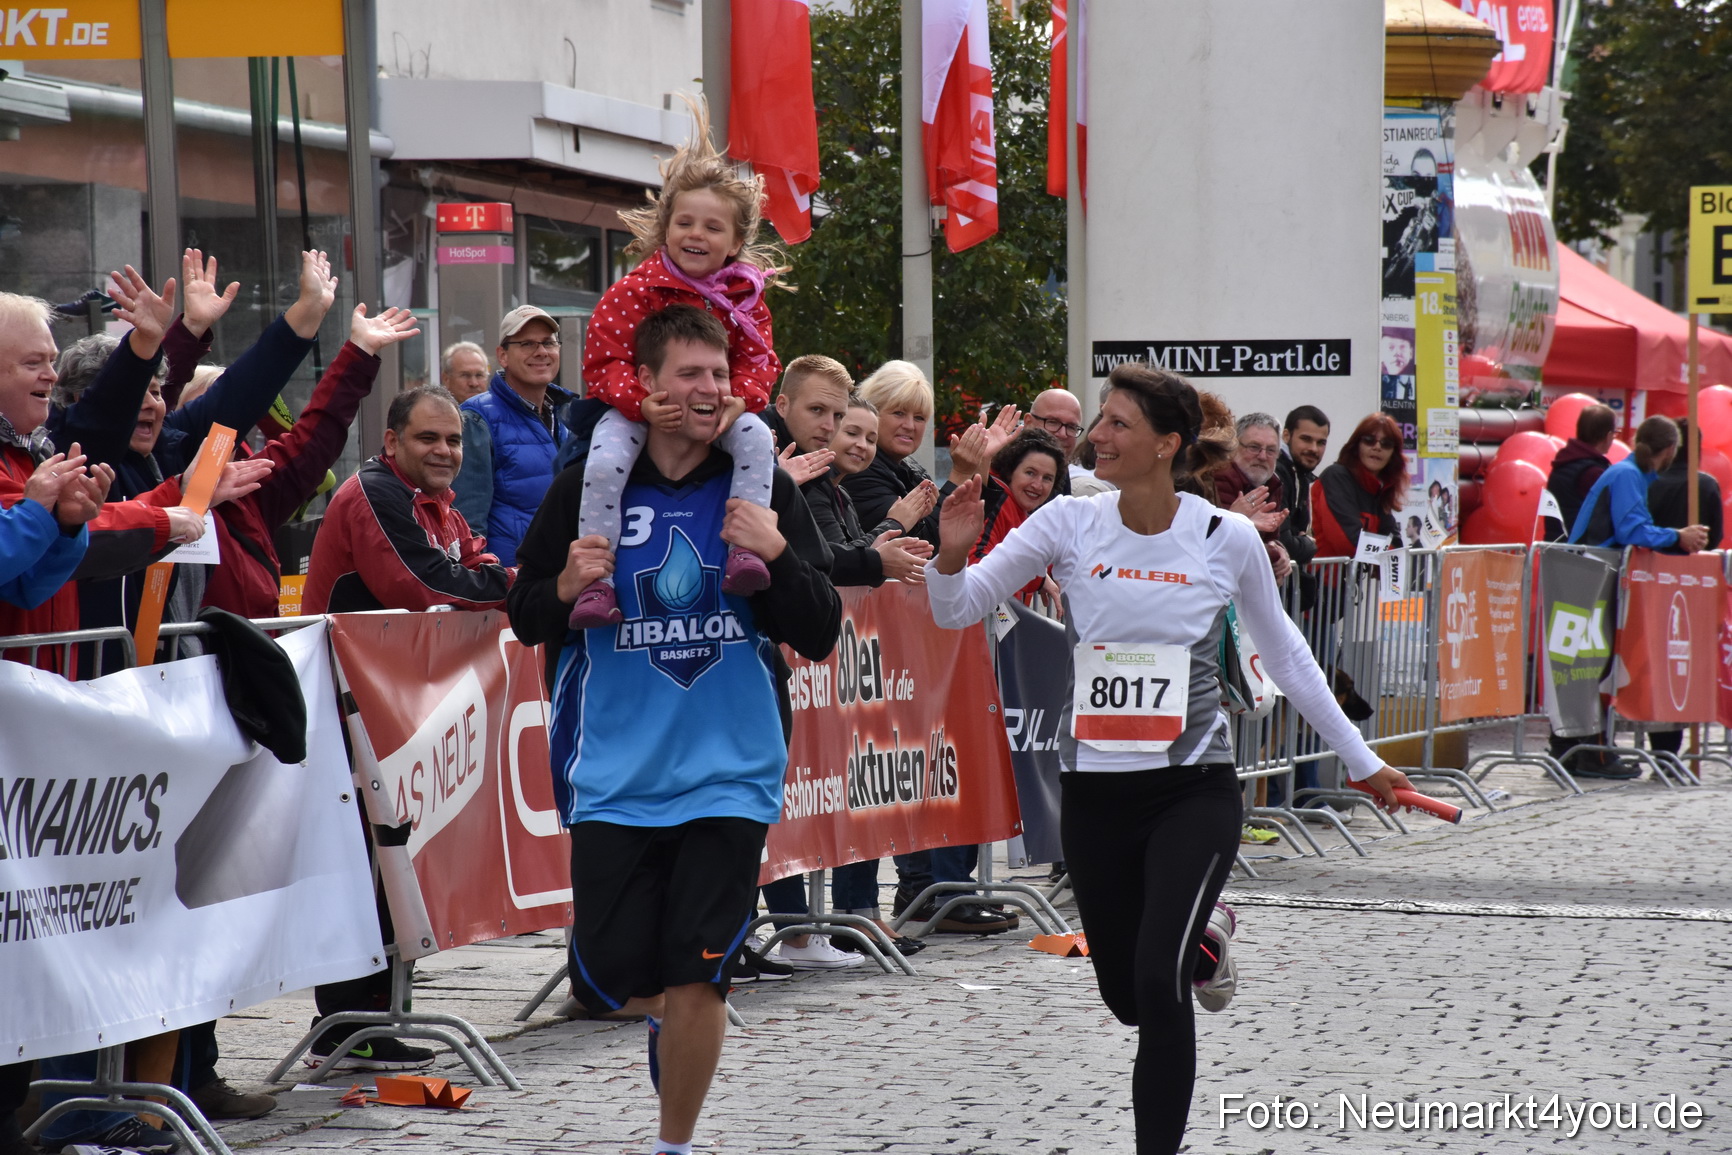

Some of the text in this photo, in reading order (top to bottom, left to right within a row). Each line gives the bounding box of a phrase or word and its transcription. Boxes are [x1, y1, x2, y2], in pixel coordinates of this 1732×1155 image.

[1397, 191, 1415, 206] CUP
[448, 247, 487, 259] HotSpot
[1420, 291, 1443, 316] 18.
[1117, 567, 1193, 586] KLEBL
[619, 615, 746, 649] FIBALON
[660, 647, 711, 661] BASKETS
[1116, 653, 1156, 663] BOCK
[896, 669, 915, 701] die
[1090, 676, 1171, 709] 8017
[432, 702, 478, 814] NEUE
[0, 771, 169, 861] YNAMICS.
